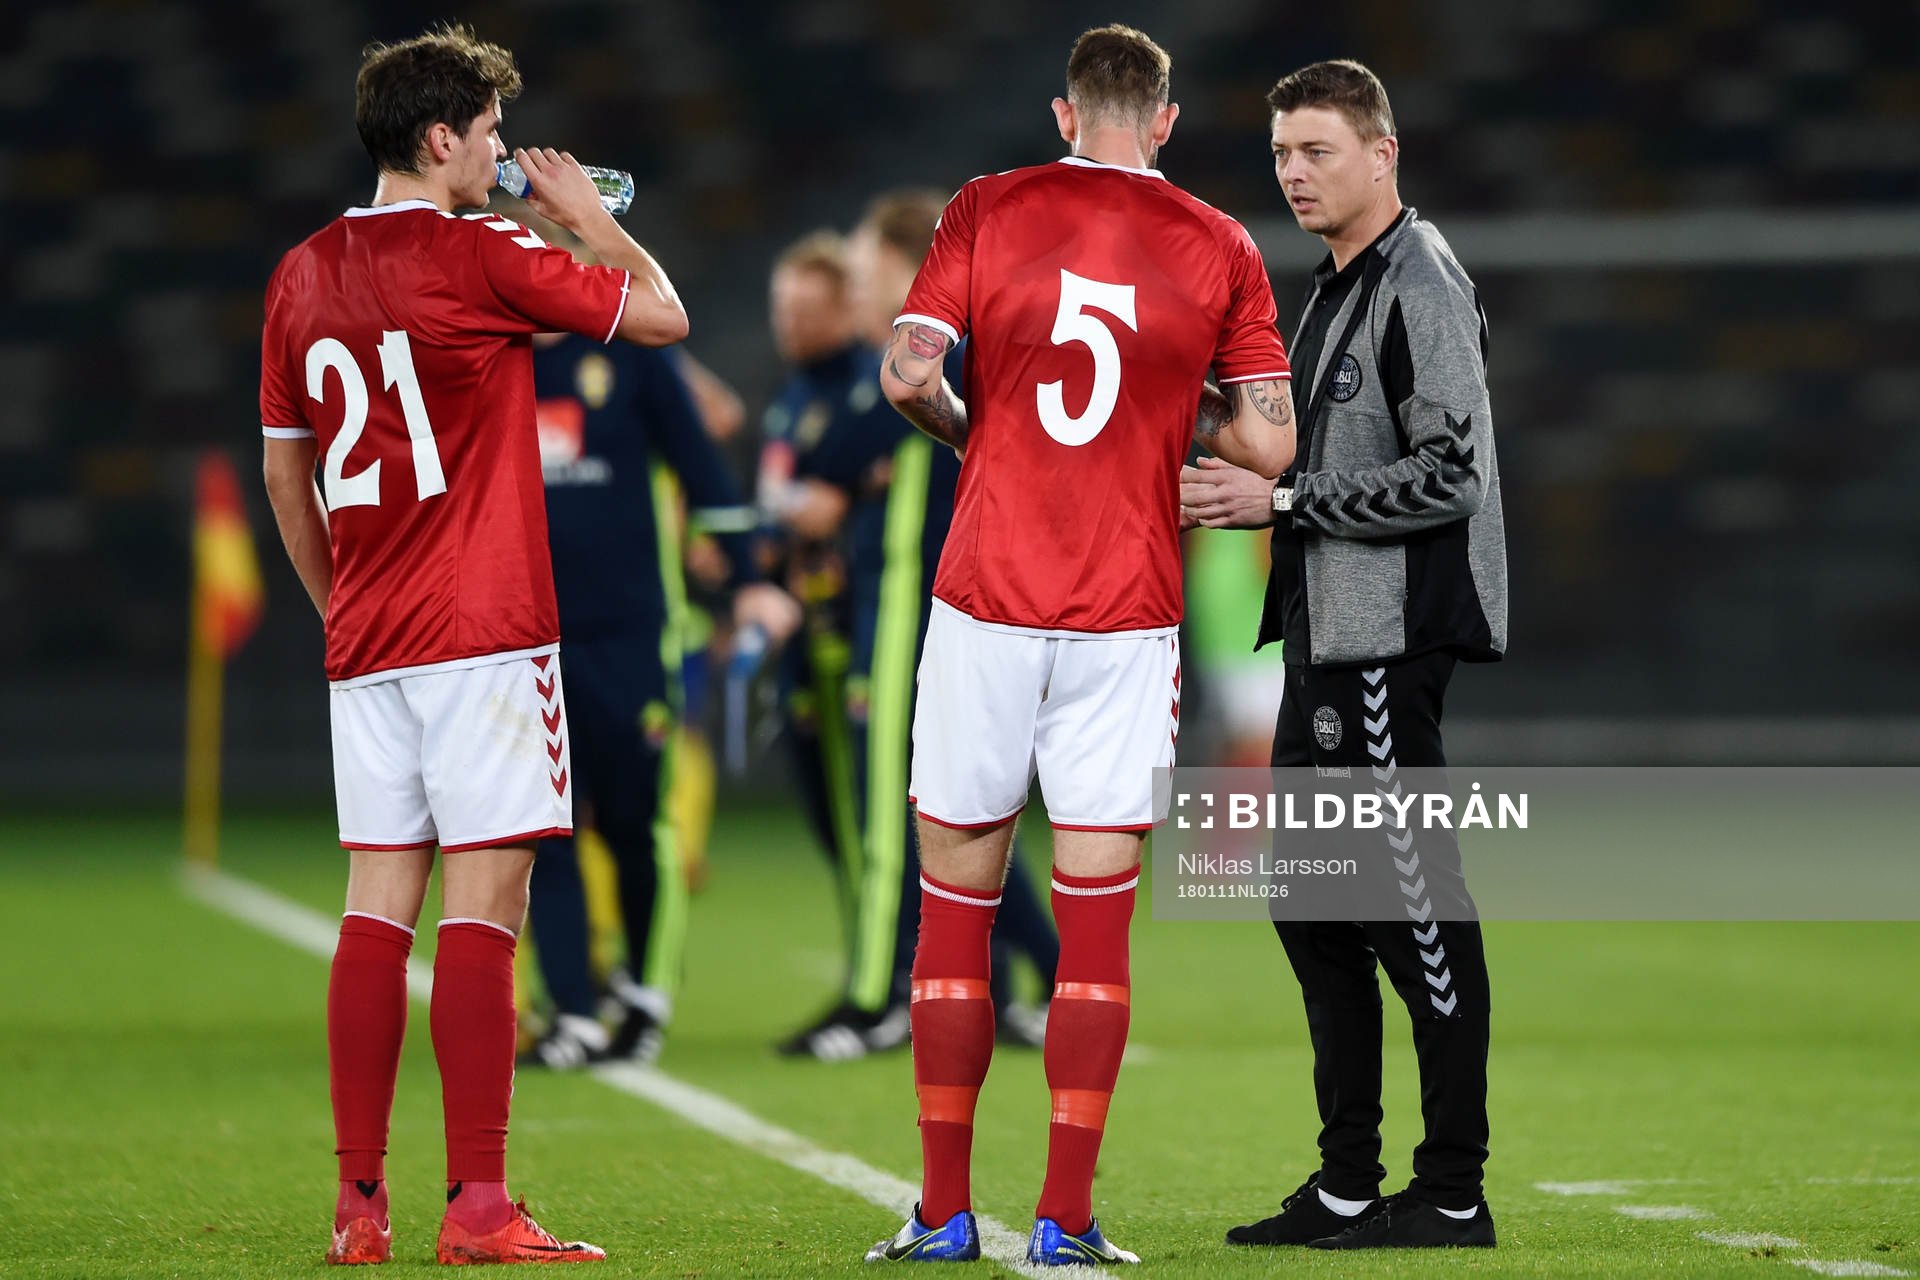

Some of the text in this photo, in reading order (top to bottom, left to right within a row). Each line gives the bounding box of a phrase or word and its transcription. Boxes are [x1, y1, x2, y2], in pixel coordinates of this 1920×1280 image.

[1036, 268, 1138, 447] 5
[305, 330, 448, 512] 21
[1316, 764, 1352, 779] hummel
[1318, 720, 1335, 734] DBU
